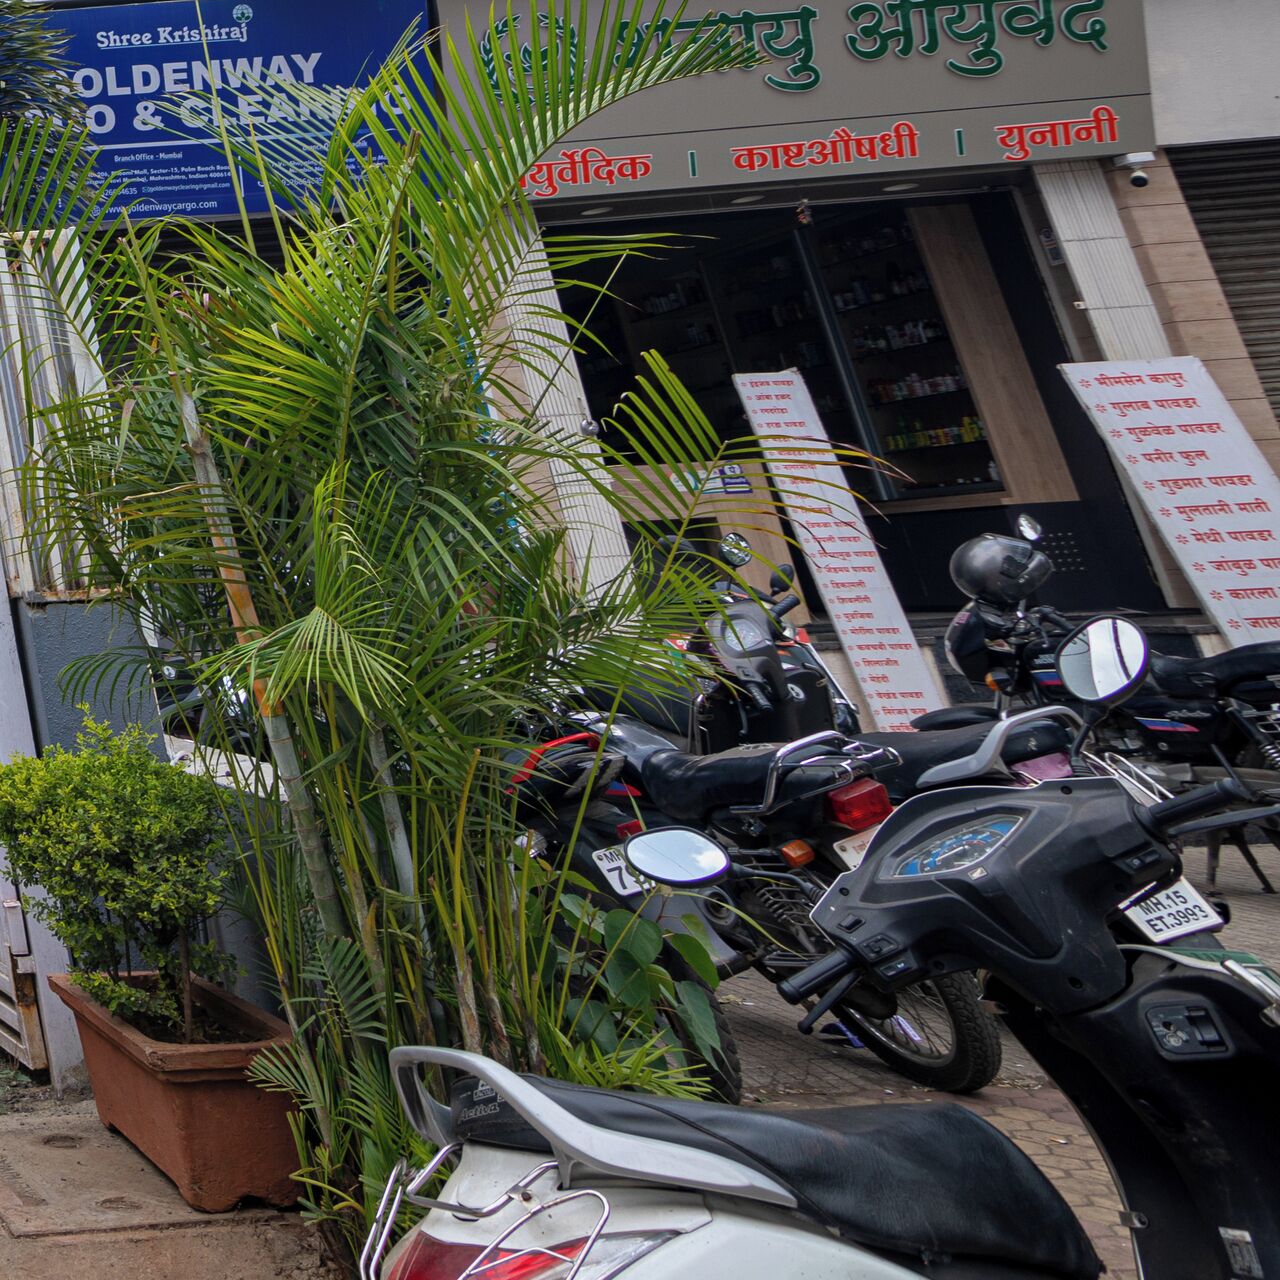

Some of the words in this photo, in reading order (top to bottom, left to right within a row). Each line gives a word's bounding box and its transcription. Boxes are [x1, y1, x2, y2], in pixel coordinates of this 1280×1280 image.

[96, 31, 152, 48] Shree
[158, 21, 248, 43] Krishiraj
[114, 154, 136, 163] Branch
[136, 153, 154, 162] Office
[159, 151, 183, 160] Mumbai
[522, 147, 654, 198] युर्वेदिक
[995, 105, 1121, 162] युनानी
[1094, 372, 1146, 388] भीमसेन
[1146, 372, 1188, 388] कापुर
[1152, 397, 1201, 409] पावडर
[1176, 422, 1225, 434] पावडर
[1141, 448, 1178, 463] पनीर
[1206, 474, 1257, 487] पावडर
[1174, 499, 1235, 522] मुलतानी
[1234, 497, 1273, 513] माती
[1190, 528, 1226, 544] मेथी
[1225, 529, 1277, 542] पावडर
[1225, 587, 1279, 600] कारला
[1140, 890, 1188, 915] MH.15
[1145, 904, 1209, 934] ET.3993
